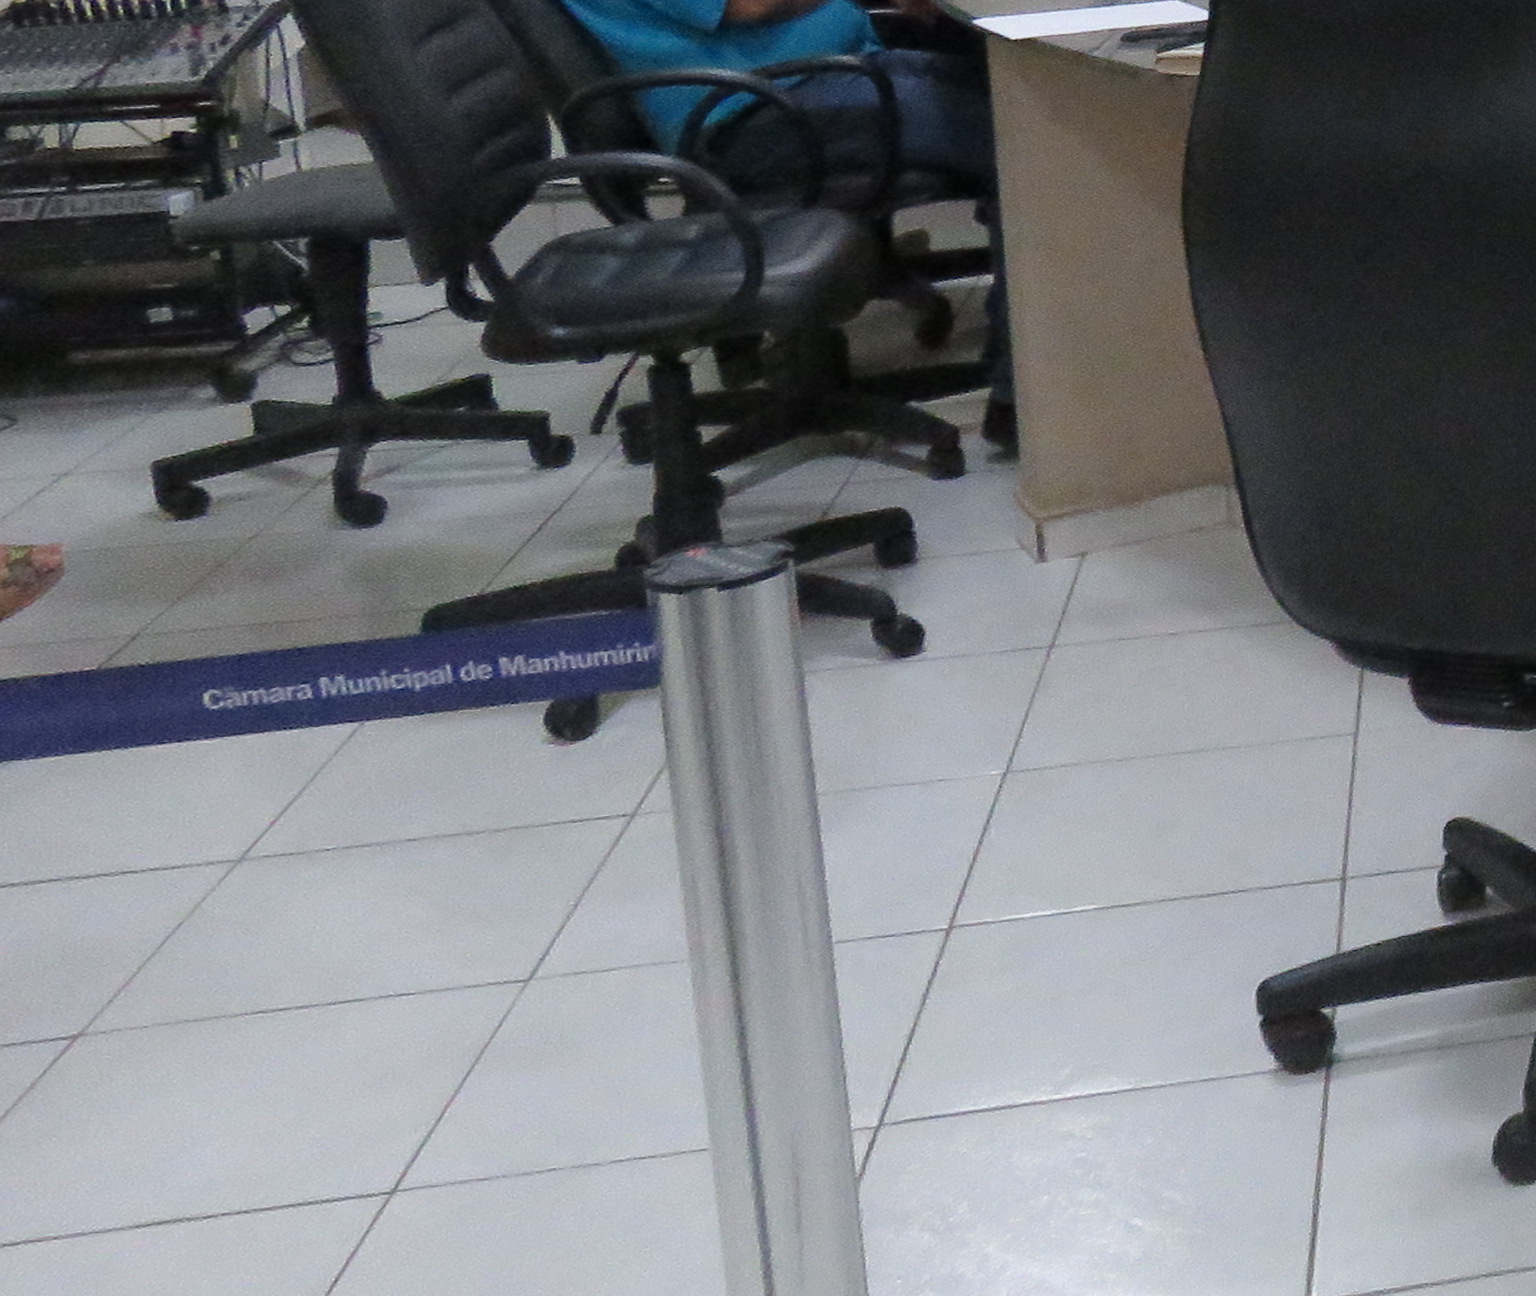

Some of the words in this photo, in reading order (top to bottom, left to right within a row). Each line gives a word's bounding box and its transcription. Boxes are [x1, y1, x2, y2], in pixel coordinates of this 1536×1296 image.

[202, 682, 315, 710] Câmara
[318, 663, 453, 700] Municipal
[459, 660, 493, 682] de
